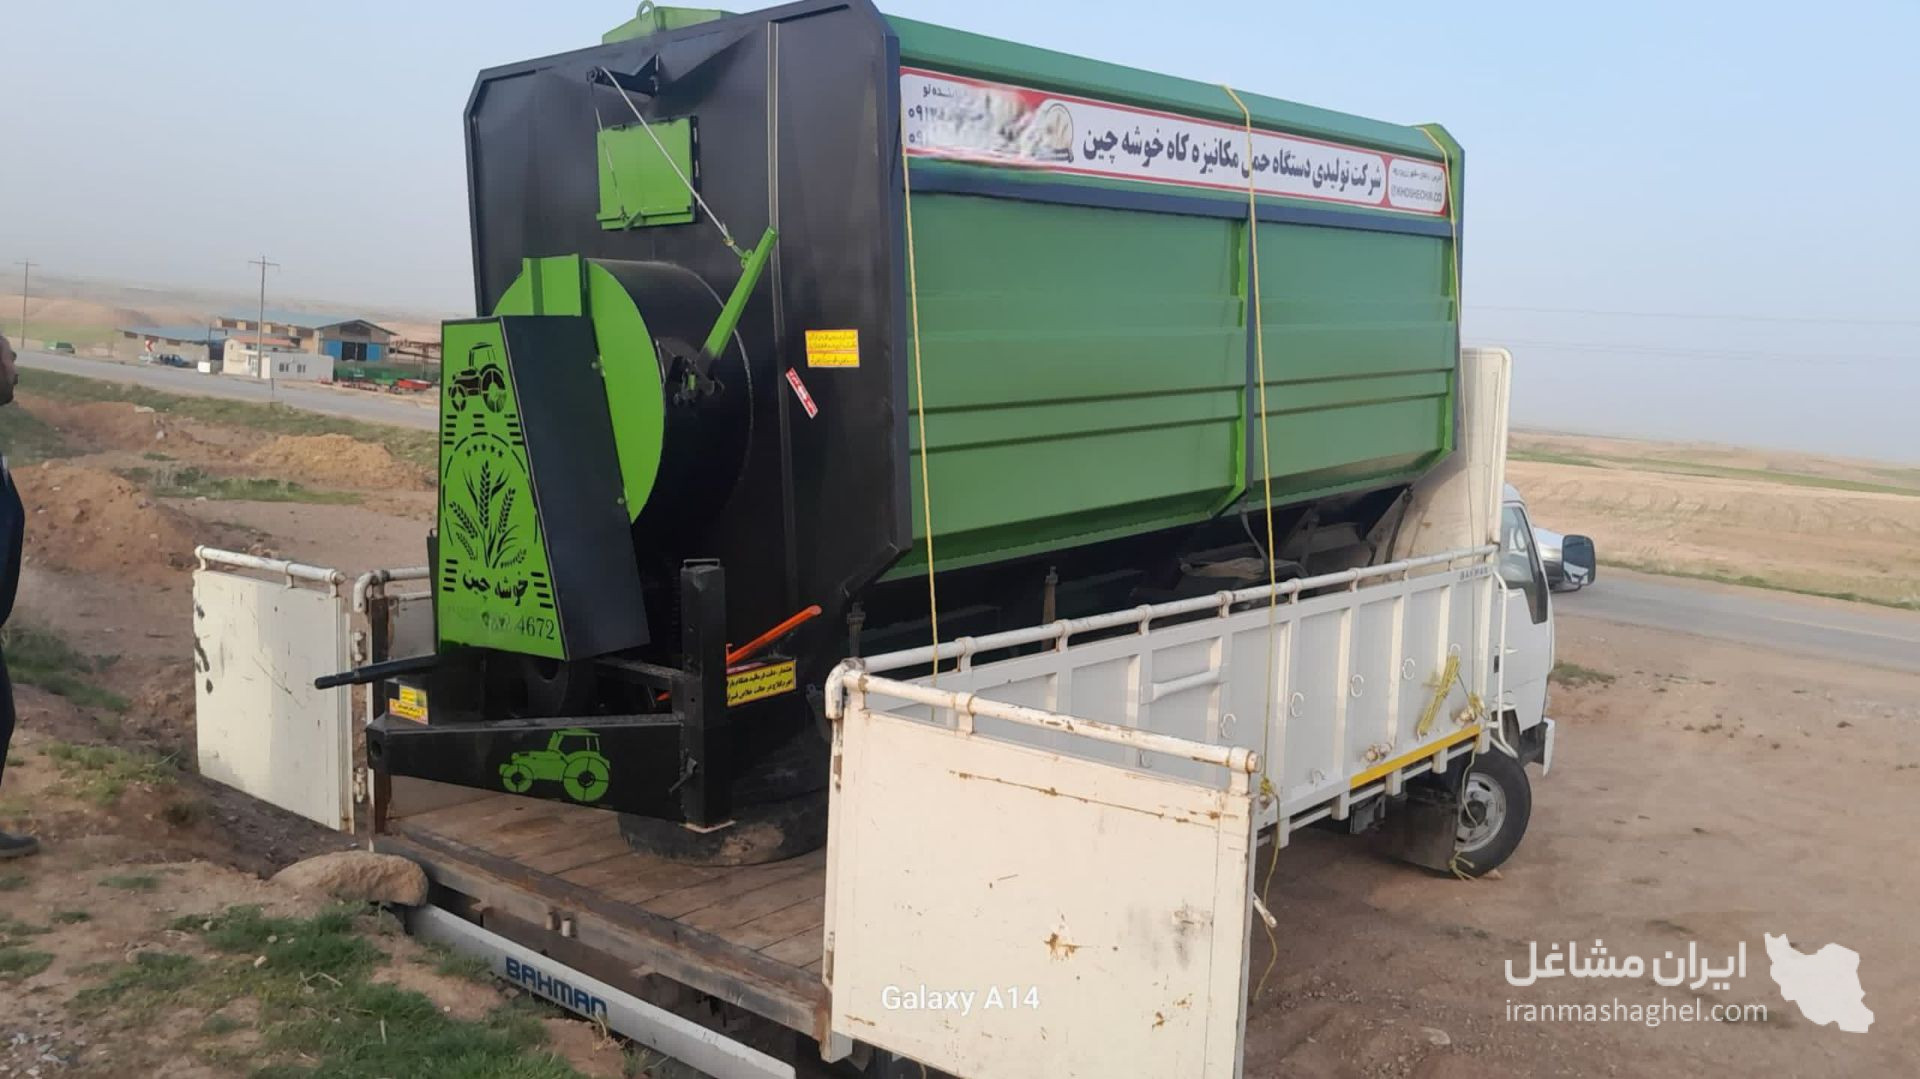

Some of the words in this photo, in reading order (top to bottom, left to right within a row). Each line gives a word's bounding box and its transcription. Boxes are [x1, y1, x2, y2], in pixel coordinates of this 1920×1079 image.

[1083, 127, 1118, 164] چین
[1121, 126, 1164, 167] خوشه
[1167, 132, 1190, 162] کاه
[1272, 150, 1311, 179] دستگاه
[1312, 155, 1350, 192] تولیدی
[1351, 158, 1382, 196] شرکت
[463, 569, 491, 602] چین
[495, 571, 529, 607] خوشه
[505, 956, 608, 1018] BAHMAN
